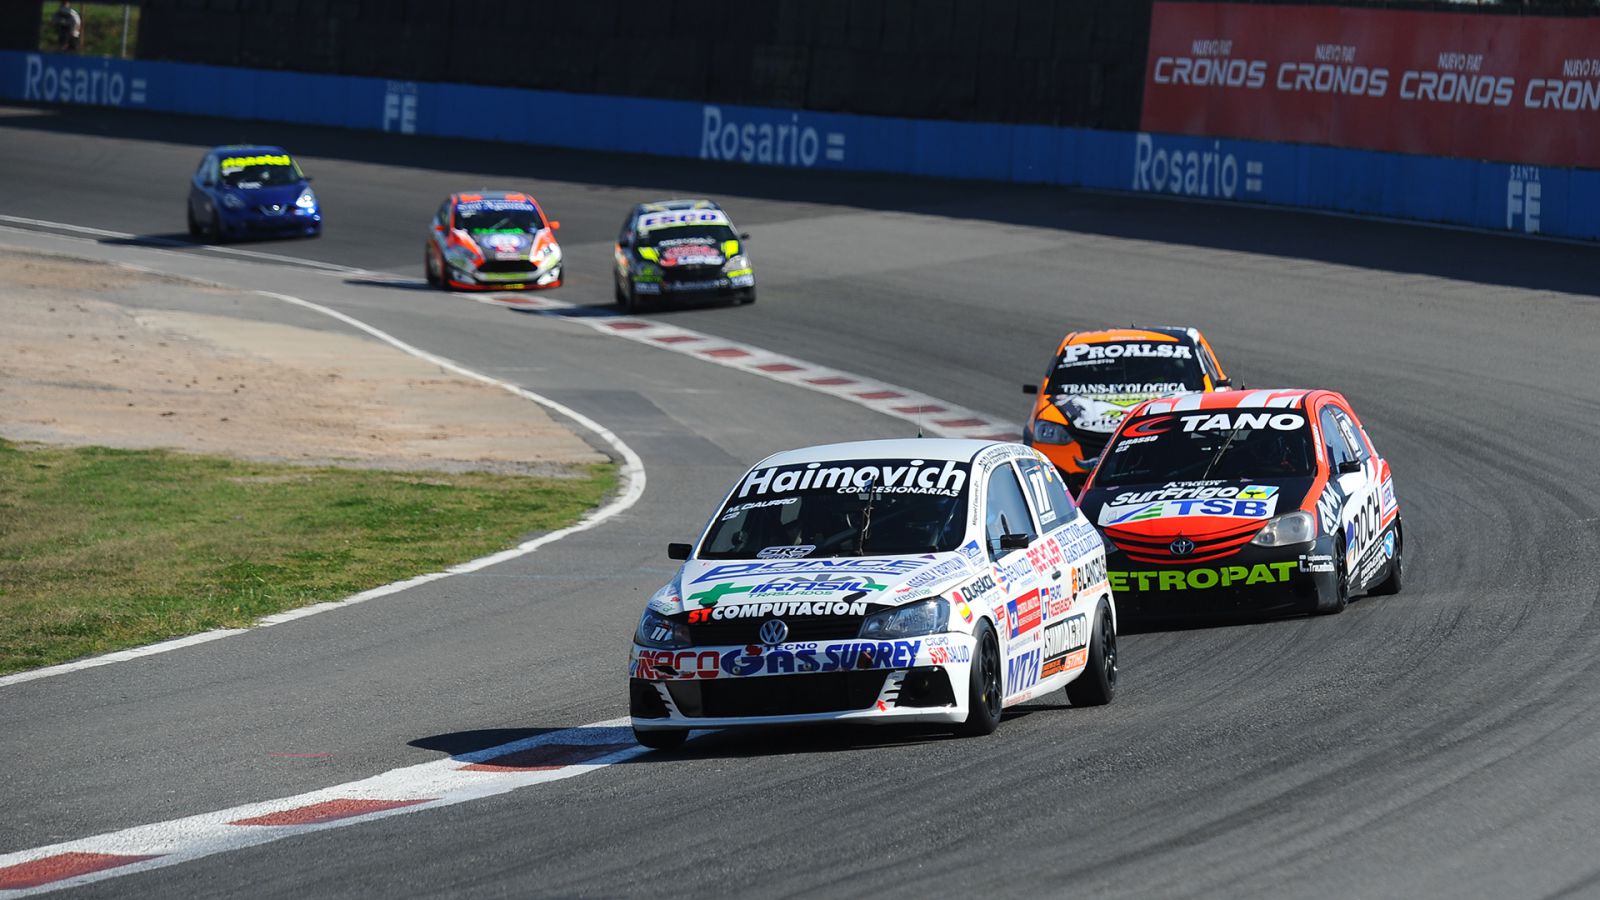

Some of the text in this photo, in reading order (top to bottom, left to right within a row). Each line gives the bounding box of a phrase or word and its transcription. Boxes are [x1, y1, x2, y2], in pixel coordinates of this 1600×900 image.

[1154, 56, 1268, 88] CRONOS
[1438, 52, 1483, 72] NUEVO FIAT
[1563, 59, 1590, 76] NUEVO
[24, 54, 124, 105] Rosario
[1276, 62, 1389, 97] CRONOS
[1400, 70, 1515, 106] CRONOS
[384, 94, 417, 134] FE
[701, 105, 819, 167] Rosario
[1132, 132, 1238, 198] Rosario
[1509, 165, 1540, 181] SANTA
[1506, 180, 1541, 233] FE
[1062, 343, 1192, 364] PROALSA
[1180, 412, 1305, 432] TANO
[738, 459, 966, 498] Haimovich
[837, 486, 960, 497] CONCESIONARIAS
[1171, 499, 1268, 517] TSB
[1055, 523, 1081, 548] HECTOR
[689, 559, 929, 585] PONCE
[748, 591, 834, 599] TRASLADOS
[766, 642, 818, 651] TECNO
